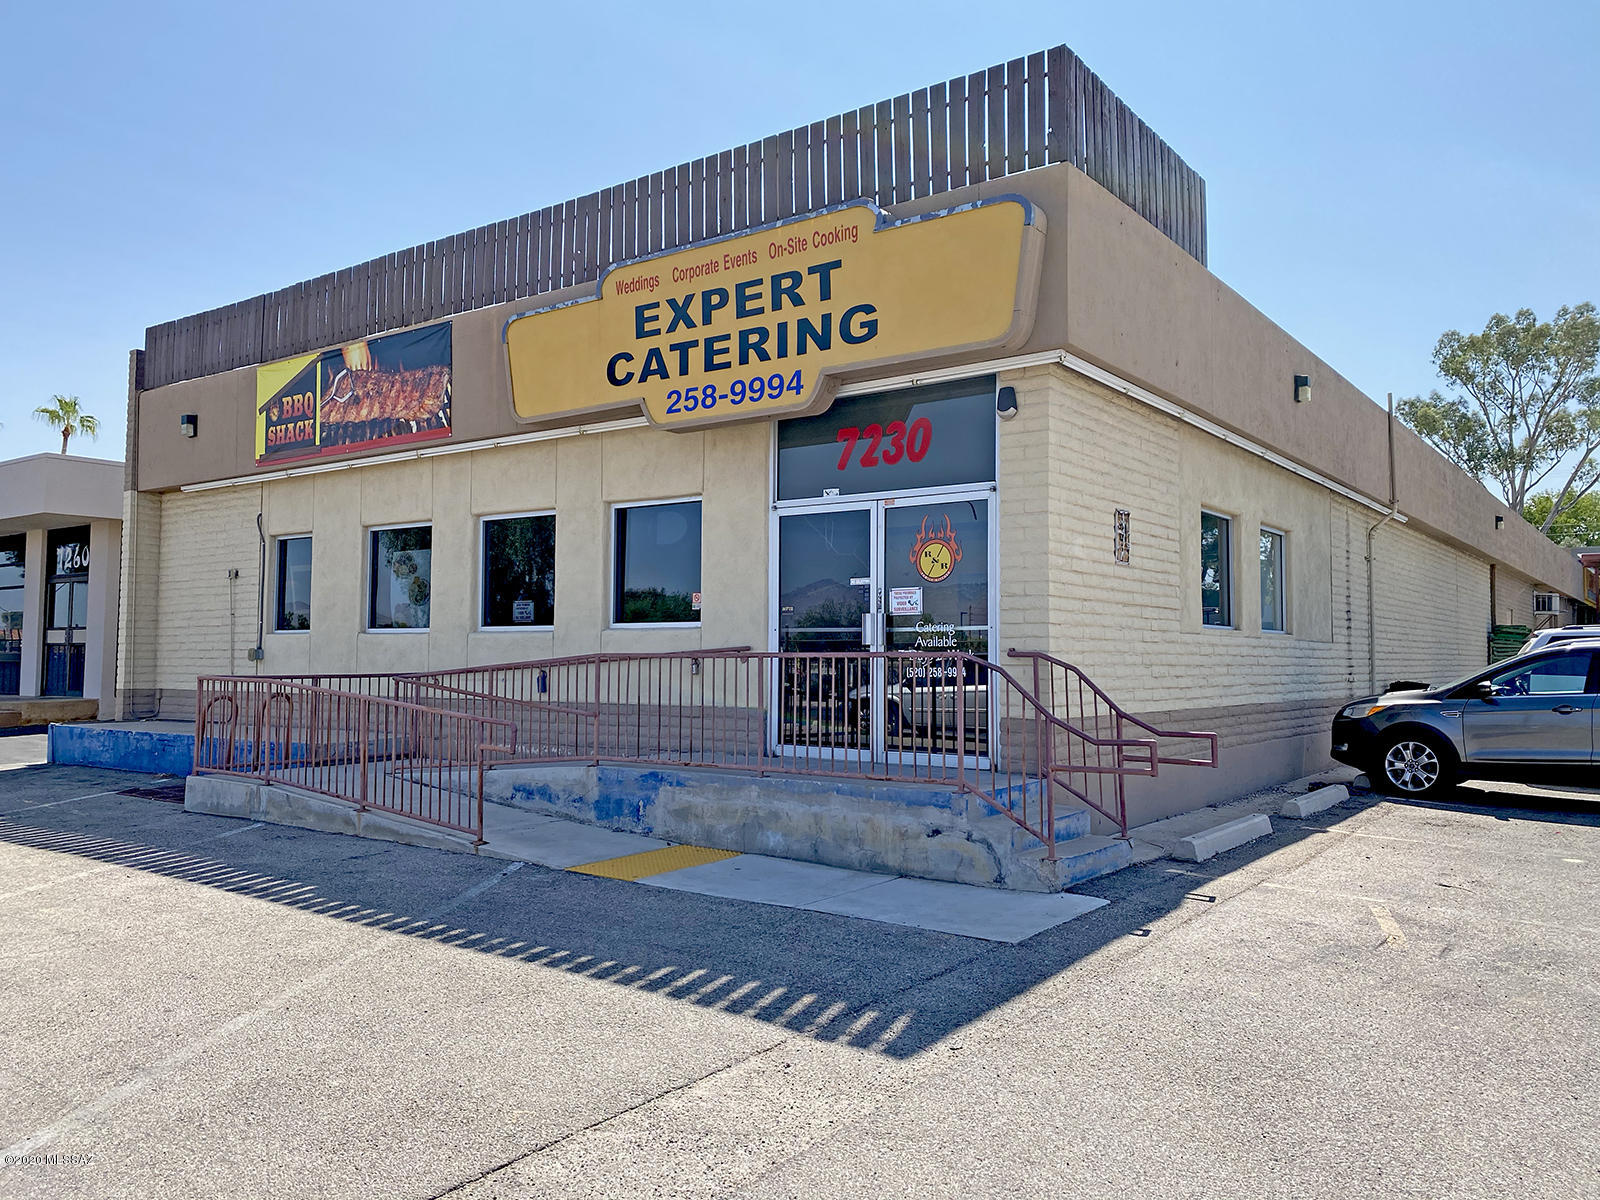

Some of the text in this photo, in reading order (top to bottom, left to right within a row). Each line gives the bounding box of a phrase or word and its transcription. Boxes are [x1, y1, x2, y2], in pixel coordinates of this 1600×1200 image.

[768, 224, 859, 260] On-Site Cooking
[672, 249, 758, 284] Corporate Events
[615, 273, 661, 297] Weddings
[634, 259, 843, 340] EXPERT
[606, 303, 880, 387] CATERING
[281, 391, 314, 419] BBQ
[665, 368, 805, 415] 258-9994
[267, 419, 314, 447] SHACK
[836, 416, 934, 471] 7230
[914, 635, 958, 647] Available
[915, 621, 956, 636] Catering
[928, 666, 967, 678] 258-994
